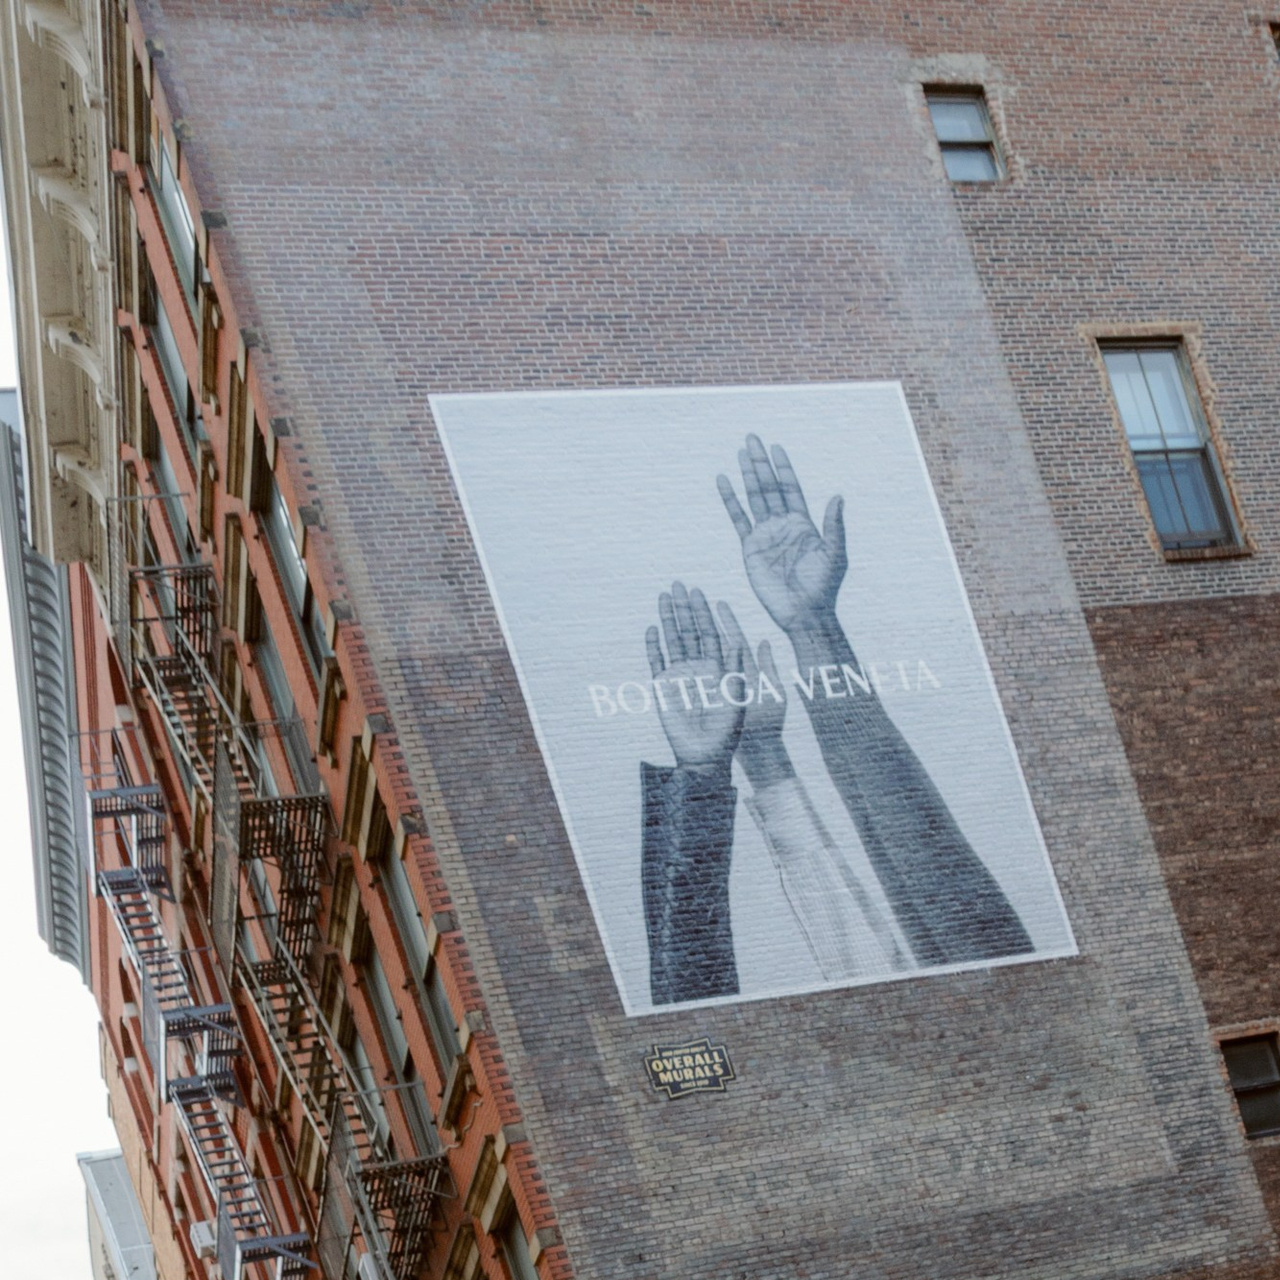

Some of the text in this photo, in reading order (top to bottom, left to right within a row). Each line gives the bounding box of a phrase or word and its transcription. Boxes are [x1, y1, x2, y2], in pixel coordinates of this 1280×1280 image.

[586, 659, 943, 718] BOTTEGA VENETA
[651, 1051, 724, 1072] OVERALL
[658, 1063, 724, 1084] MURALS
